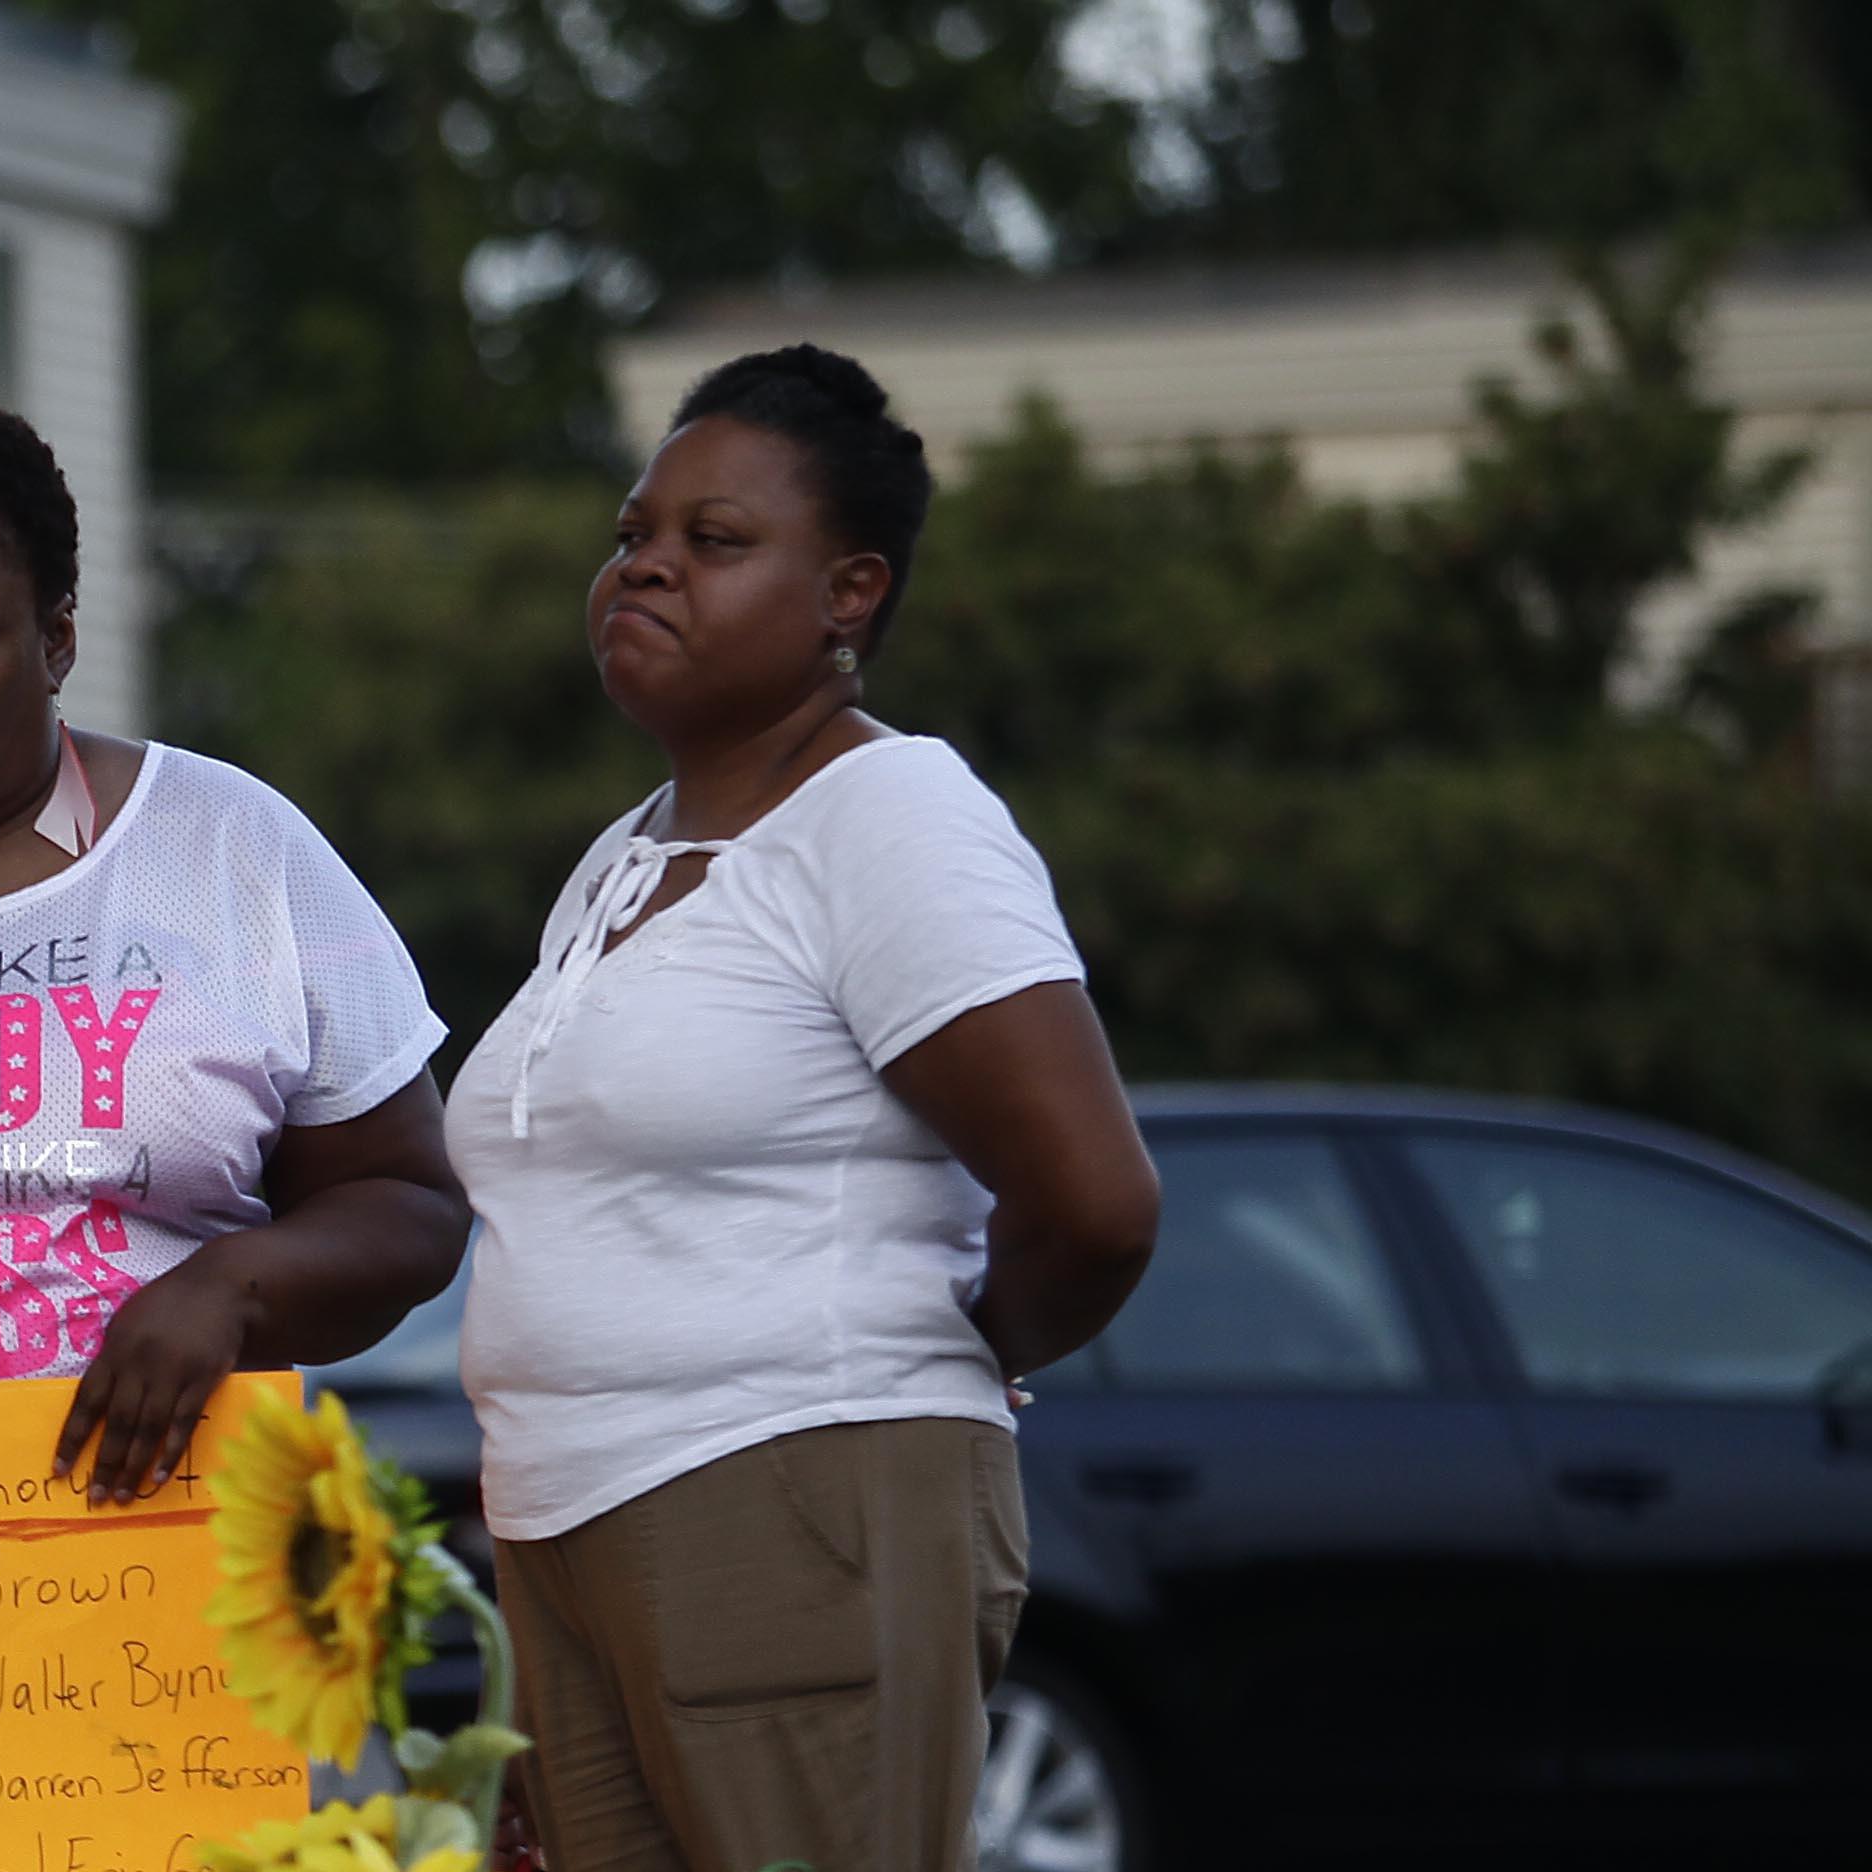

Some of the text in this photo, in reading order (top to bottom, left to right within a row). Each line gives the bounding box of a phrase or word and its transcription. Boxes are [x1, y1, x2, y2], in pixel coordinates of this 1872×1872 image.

[114, 940, 163, 986] A
[120, 1143, 153, 1202] A
[112, 1735, 303, 1795] Jefferson
